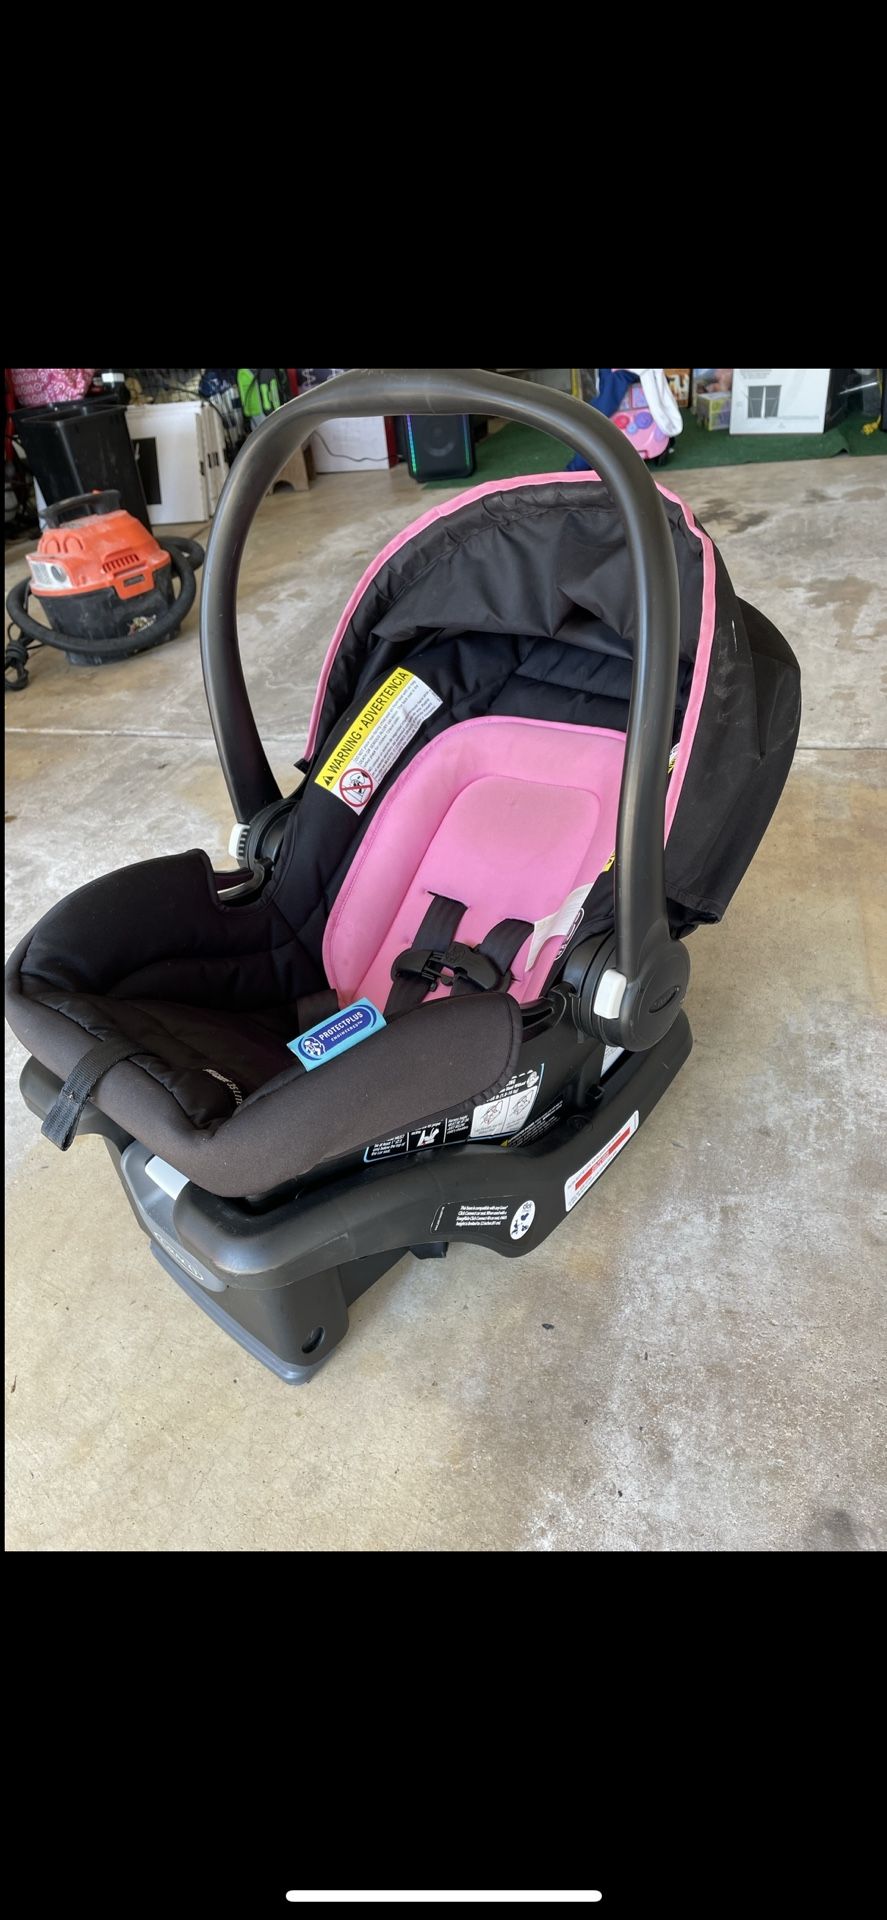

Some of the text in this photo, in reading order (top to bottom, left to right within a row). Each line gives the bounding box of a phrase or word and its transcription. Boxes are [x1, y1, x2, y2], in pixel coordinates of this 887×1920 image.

[328, 730, 362, 774] WARNING
[360, 671, 409, 729] ADVERTENCIA
[318, 1011, 363, 1041] PROTECTPLUS
